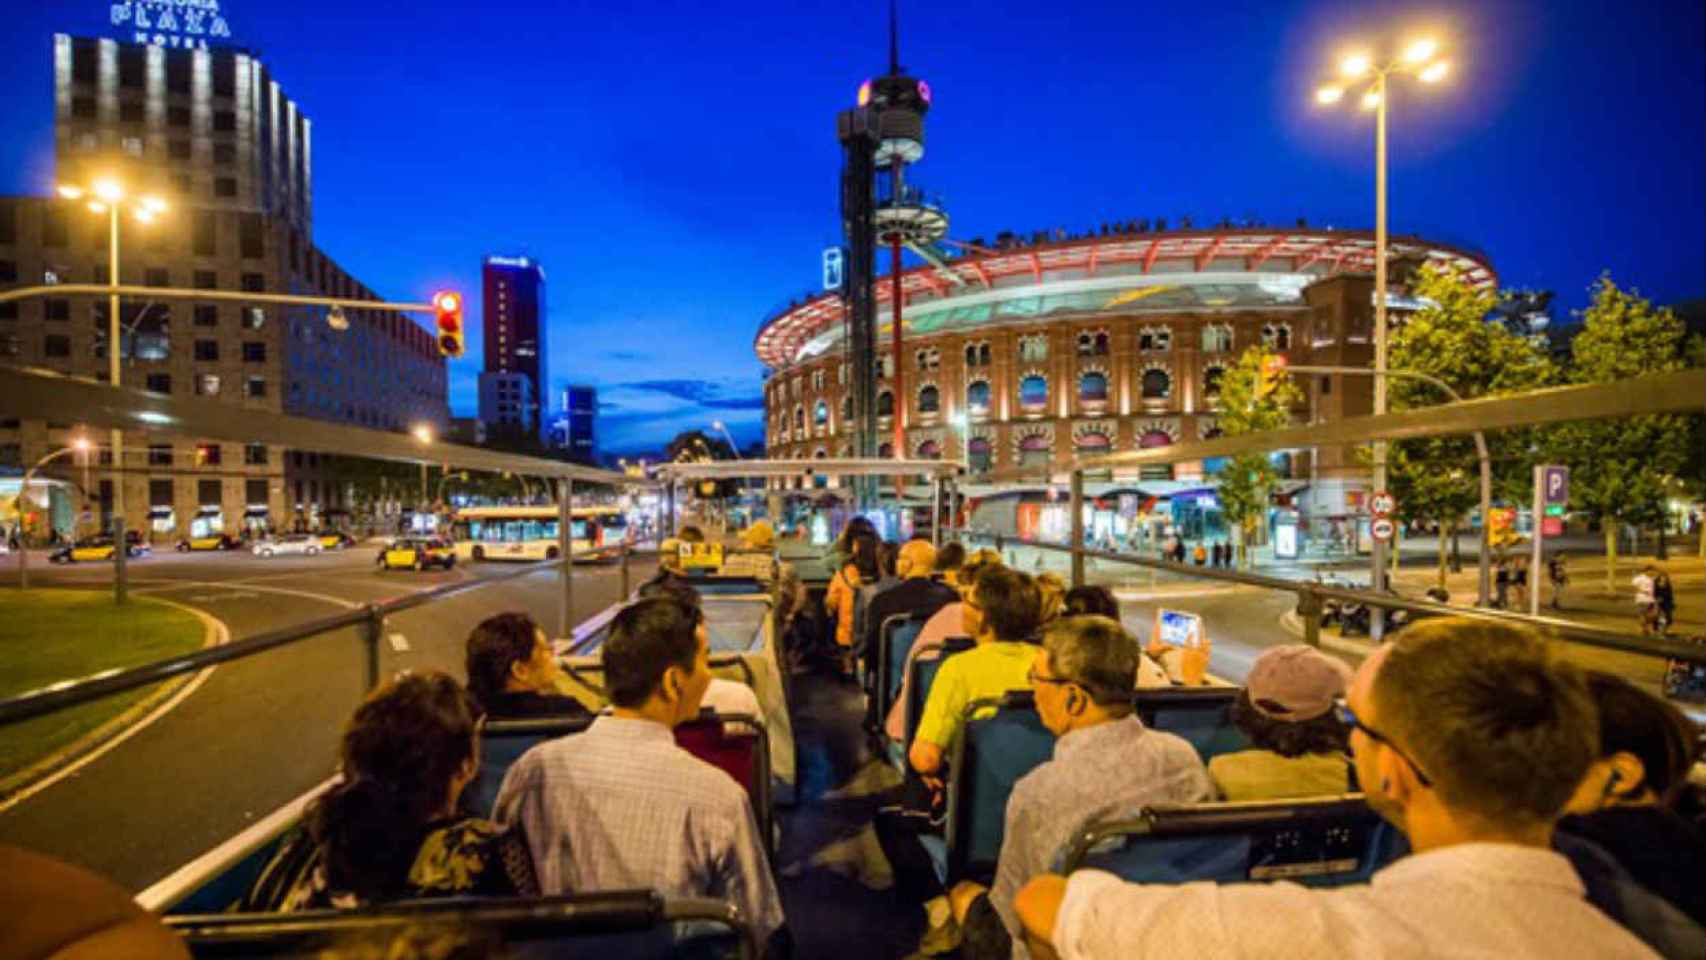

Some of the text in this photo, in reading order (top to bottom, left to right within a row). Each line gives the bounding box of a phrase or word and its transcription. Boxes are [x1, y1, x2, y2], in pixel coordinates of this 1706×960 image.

[110, 3, 231, 37] PLAZA
[135, 32, 208, 50] HOTEL
[1549, 473, 1563, 497] P
